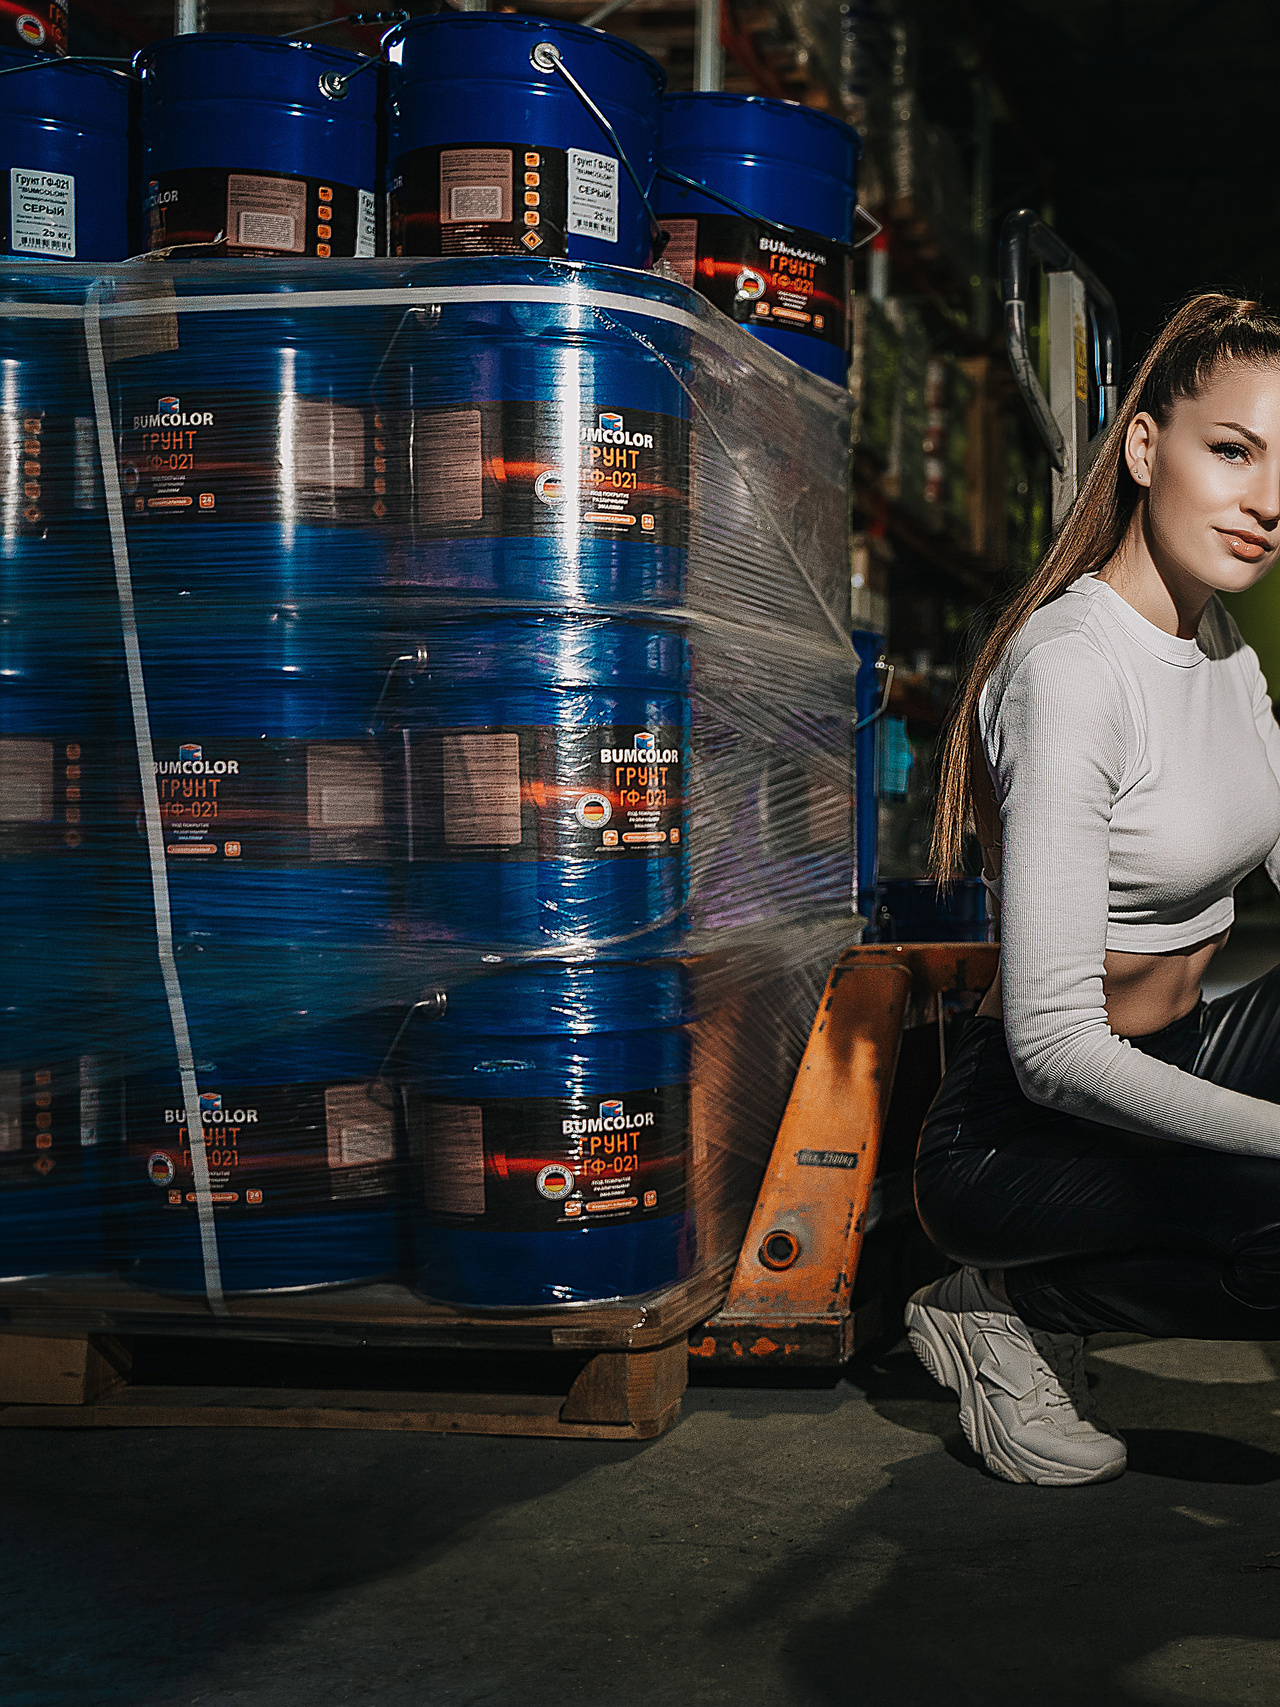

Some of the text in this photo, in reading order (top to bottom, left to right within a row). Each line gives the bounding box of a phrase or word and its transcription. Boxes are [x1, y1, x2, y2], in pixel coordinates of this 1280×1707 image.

[16, 173, 40, 186] Грунт
[22, 203, 65, 216] СЕРЫЙ
[769, 254, 817, 280] ГРУНТ
[133, 412, 214, 430] BUMCOLOR
[142, 430, 197, 451] ГРУНТ
[578, 446, 640, 470] ГРУНТ
[582, 468, 637, 490] ГФ-021
[600, 748, 679, 764] BUMCOLOR
[616, 766, 669, 787] ГРУНТ
[161, 778, 221, 798] ГРУНТ
[620, 788, 667, 807] ГФ-021
[165, 801, 218, 818] ГФ-021
[164, 1109, 259, 1124] BUCOLOR
[562, 1111, 655, 1135] BUMCOLOR
[179, 1127, 241, 1146] ГУНТ
[579, 1131, 641, 1157] ГРУНТ
[183, 1149, 239, 1167] Г-021
[583, 1154, 639, 1176] ГФ-021
